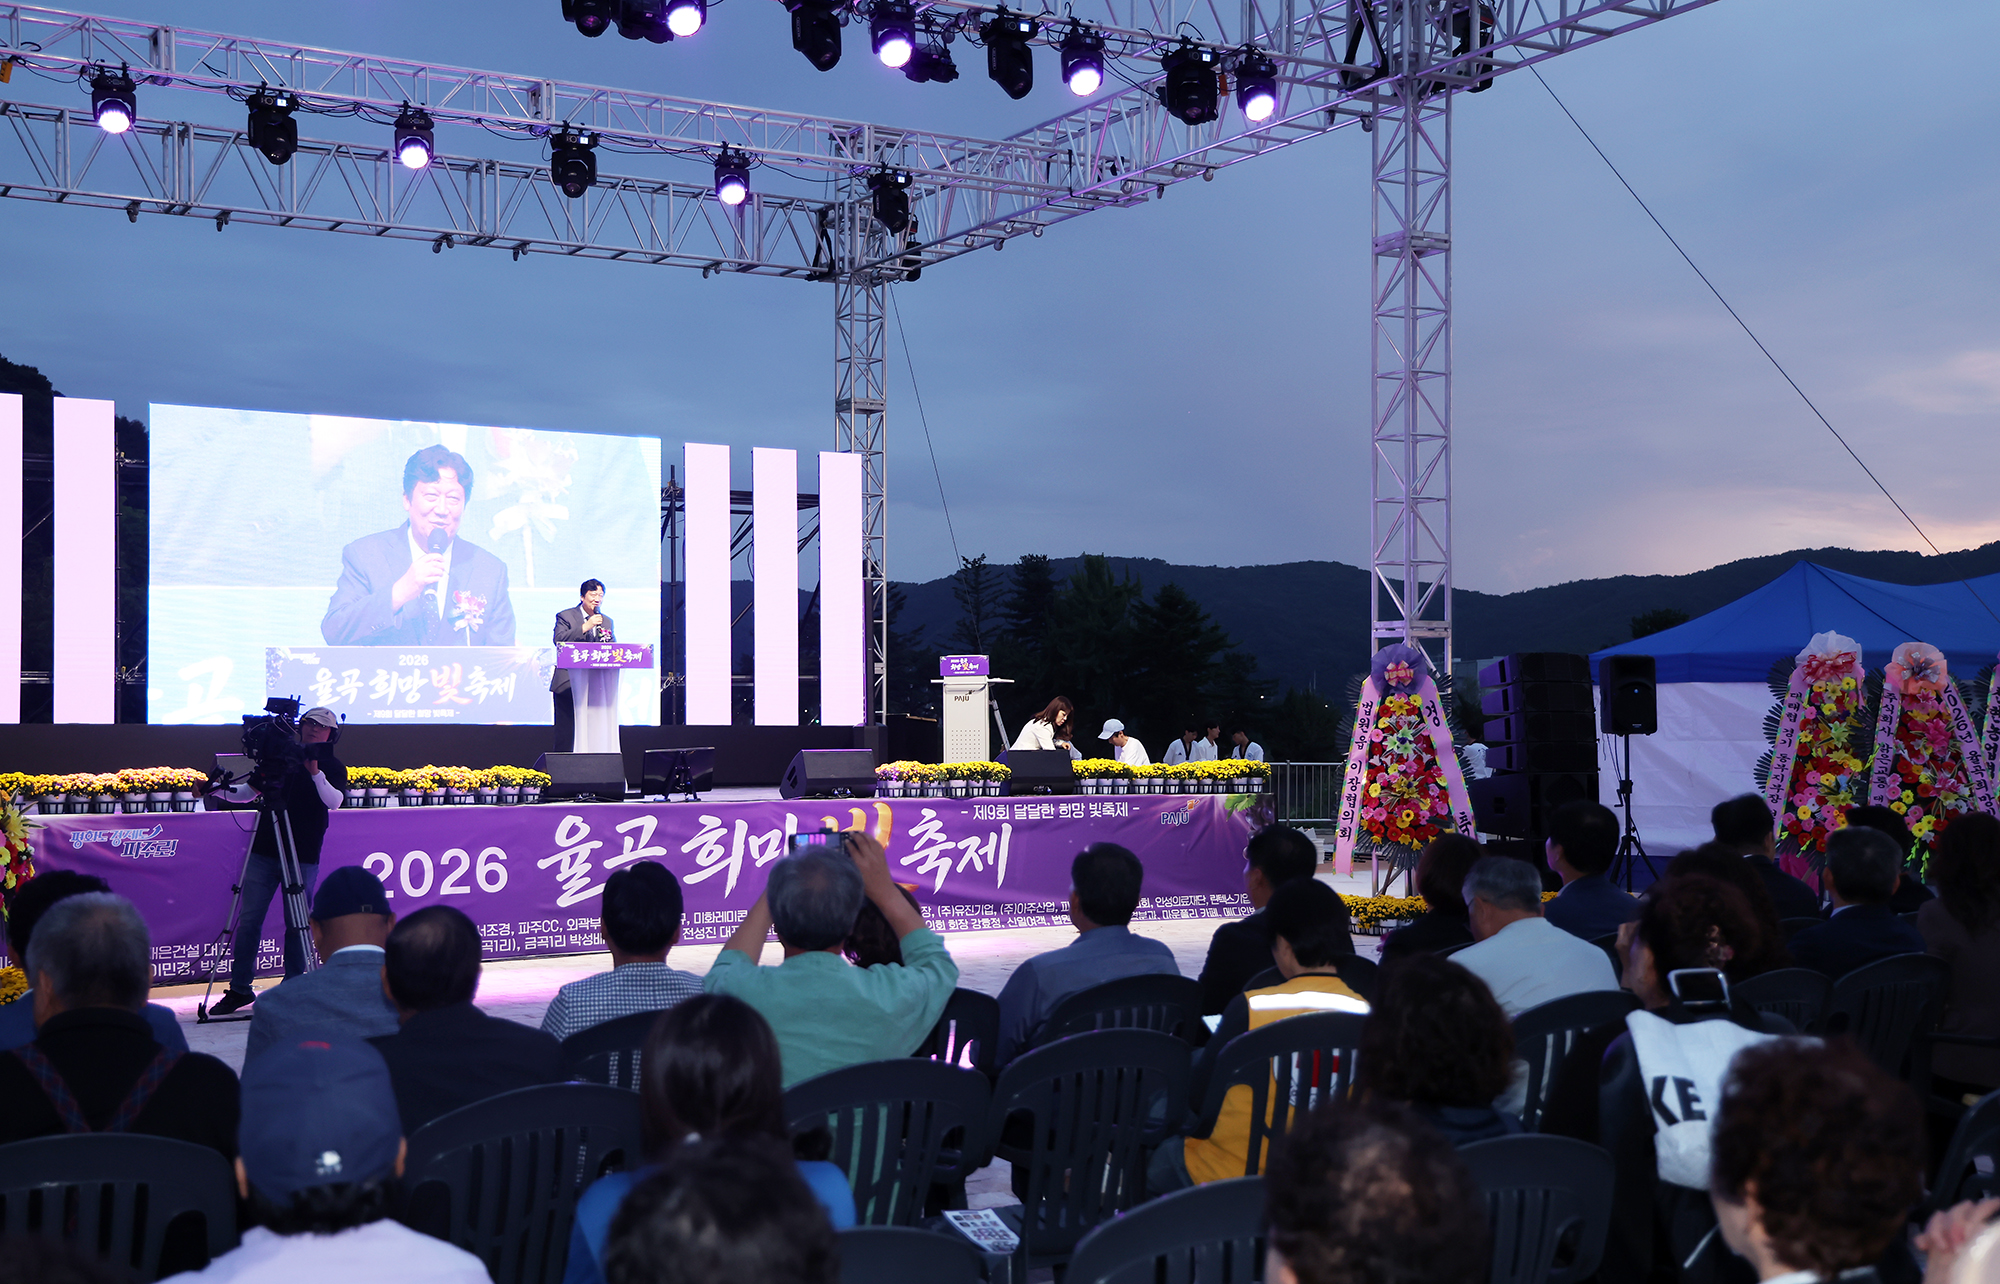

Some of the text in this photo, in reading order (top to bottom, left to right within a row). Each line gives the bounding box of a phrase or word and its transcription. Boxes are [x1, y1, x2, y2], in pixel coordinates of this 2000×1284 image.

[398, 654, 429, 666] 2026
[308, 667, 365, 707] 율곡
[368, 667, 429, 706] 희망
[972, 804, 1010, 820] 제9회
[1013, 803, 1055, 819] 달달한
[1058, 802, 1085, 818] 희망
[1089, 801, 1129, 818] 빛축제
[1160, 810, 1191, 826] PAJU
[120, 839, 179, 859] 파주로!
[362, 844, 508, 899] 2026
[900, 807, 1013, 895] 축제
[518, 919, 563, 935] 파주CC,
[937, 903, 998, 918] (주)유진기업,
[1000, 901, 1058, 916] (주)아주산업,
[525, 934, 566, 950] 금곡1리
[682, 926, 717, 940] 전성진
[948, 918, 968, 931] 회장
